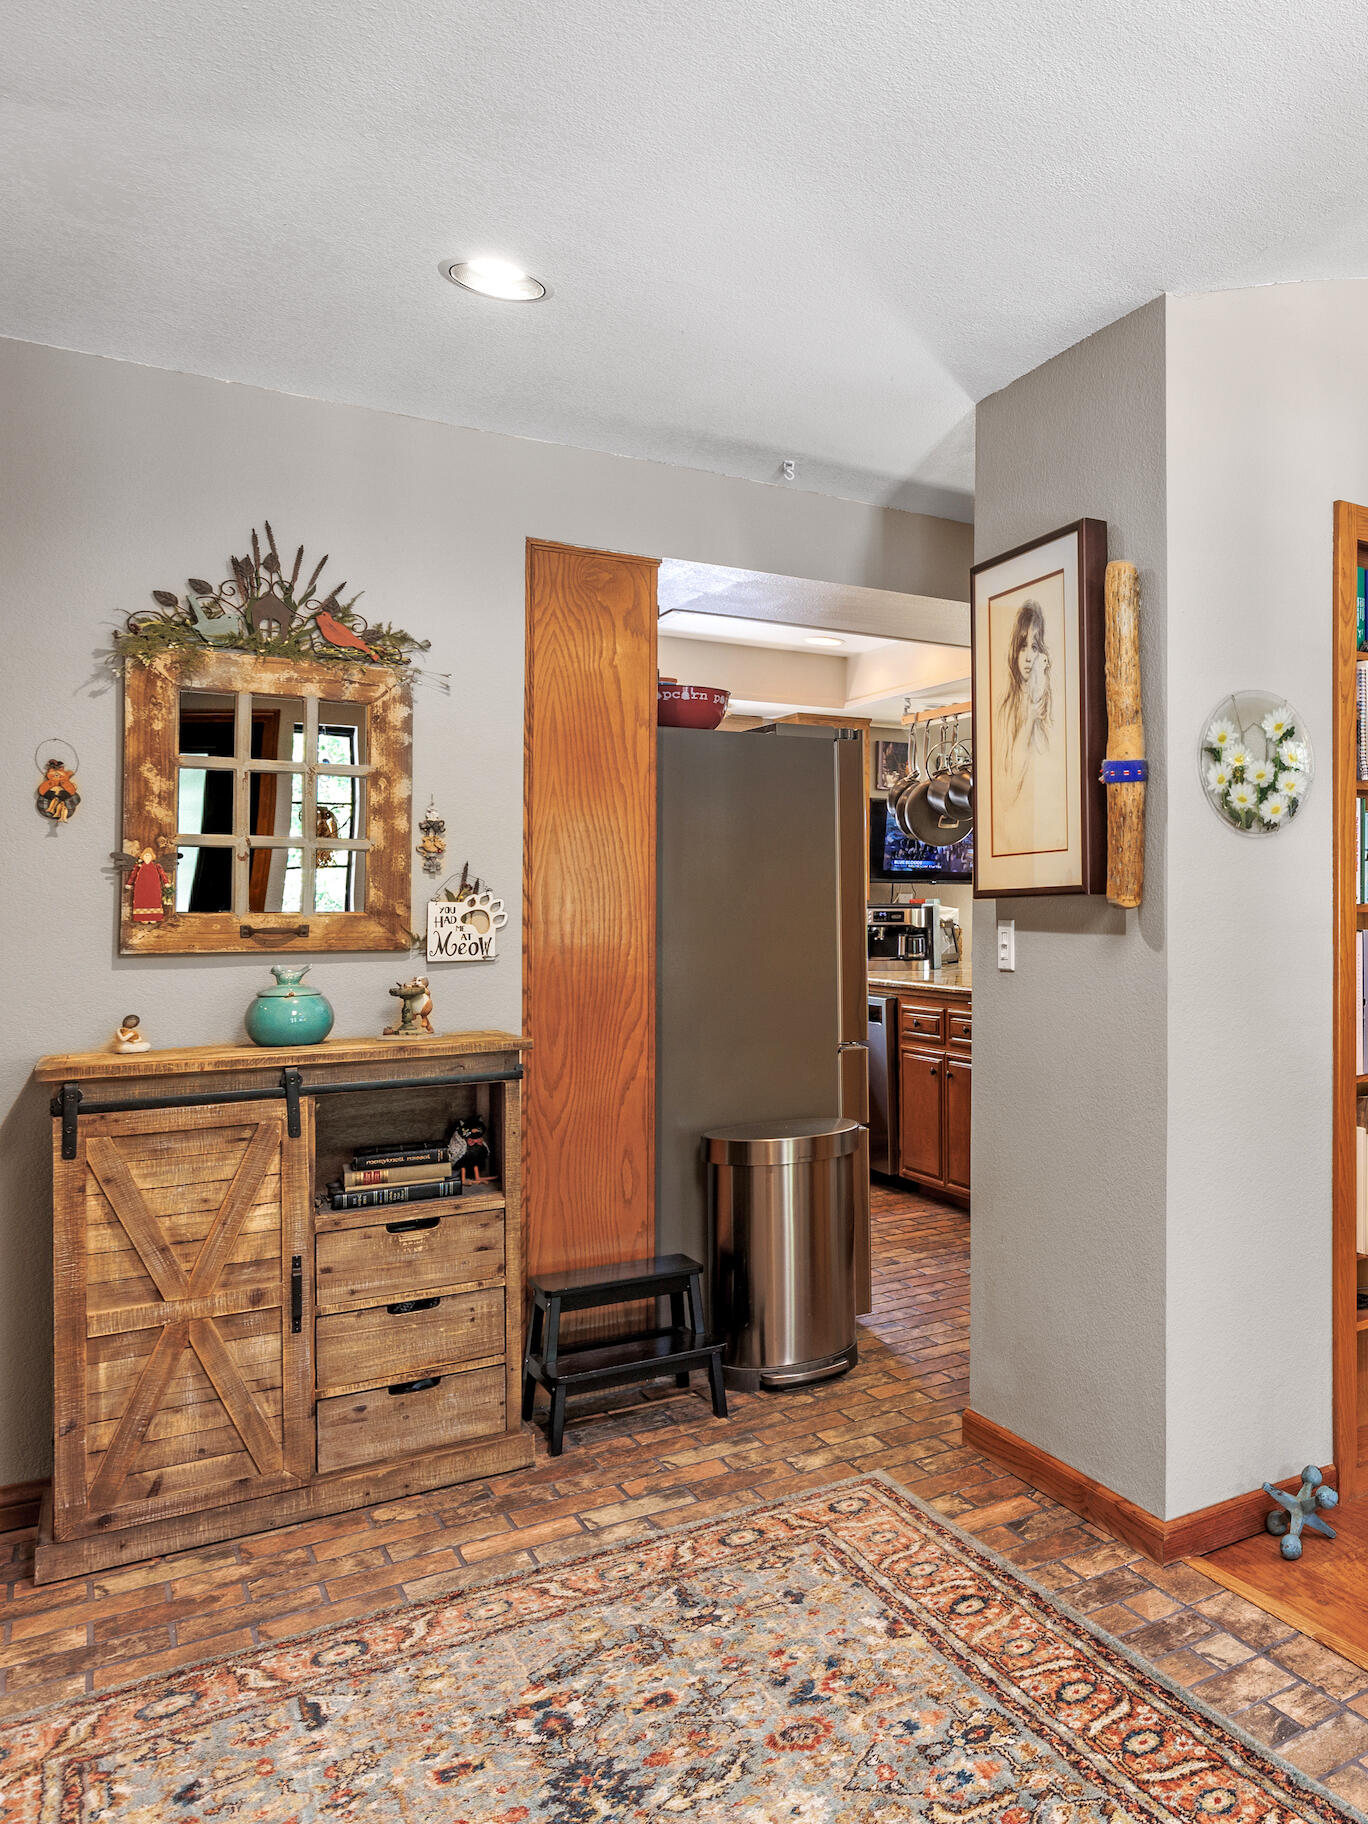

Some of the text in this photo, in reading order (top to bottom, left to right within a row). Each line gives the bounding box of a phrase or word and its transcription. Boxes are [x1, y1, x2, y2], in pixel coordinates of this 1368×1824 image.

[439, 906, 456, 914] YOU
[434, 915, 457, 928] HAD
[461, 933, 472, 941] AT
